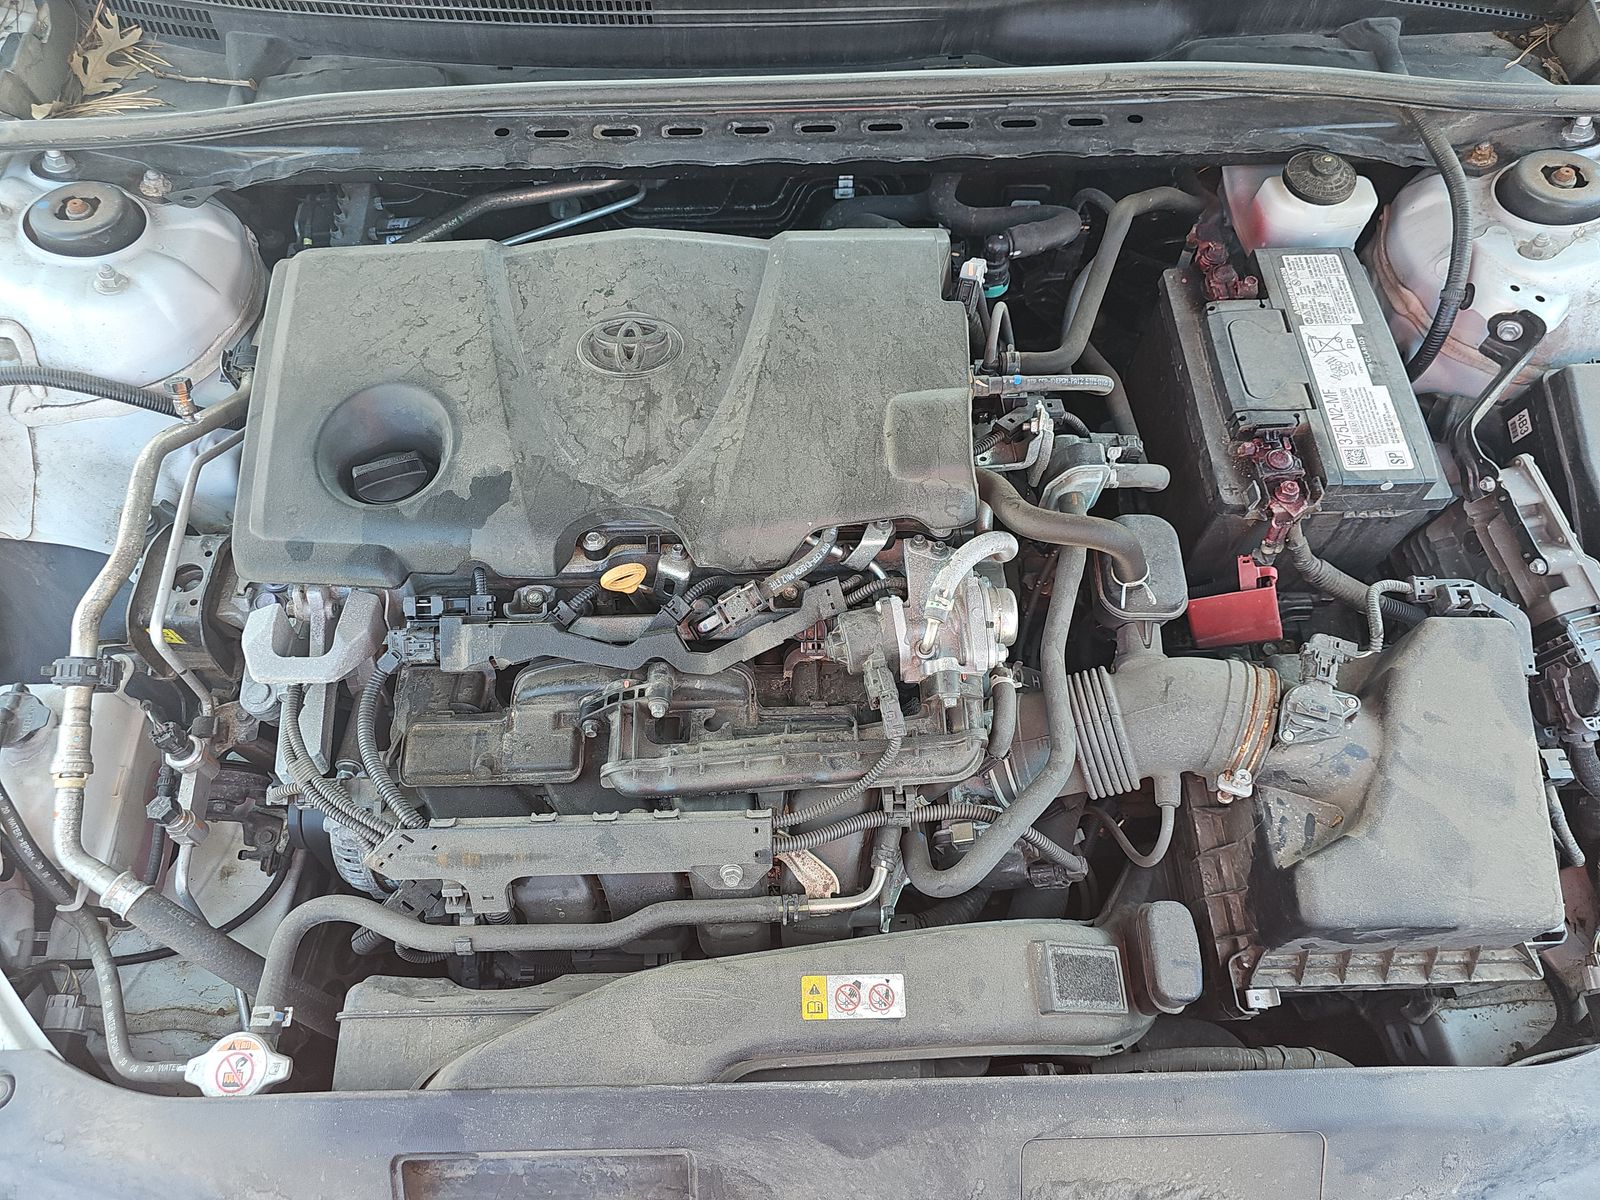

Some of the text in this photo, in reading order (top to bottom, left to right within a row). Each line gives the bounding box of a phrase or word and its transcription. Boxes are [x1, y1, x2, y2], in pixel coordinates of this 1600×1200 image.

[1344, 338, 1355, 349] Pb
[1357, 336, 1372, 362] CLARIOS
[1322, 388, 1353, 446] 375LN2-MF
[1389, 452, 1405, 465] SP
[7, 817, 22, 838] WATER
